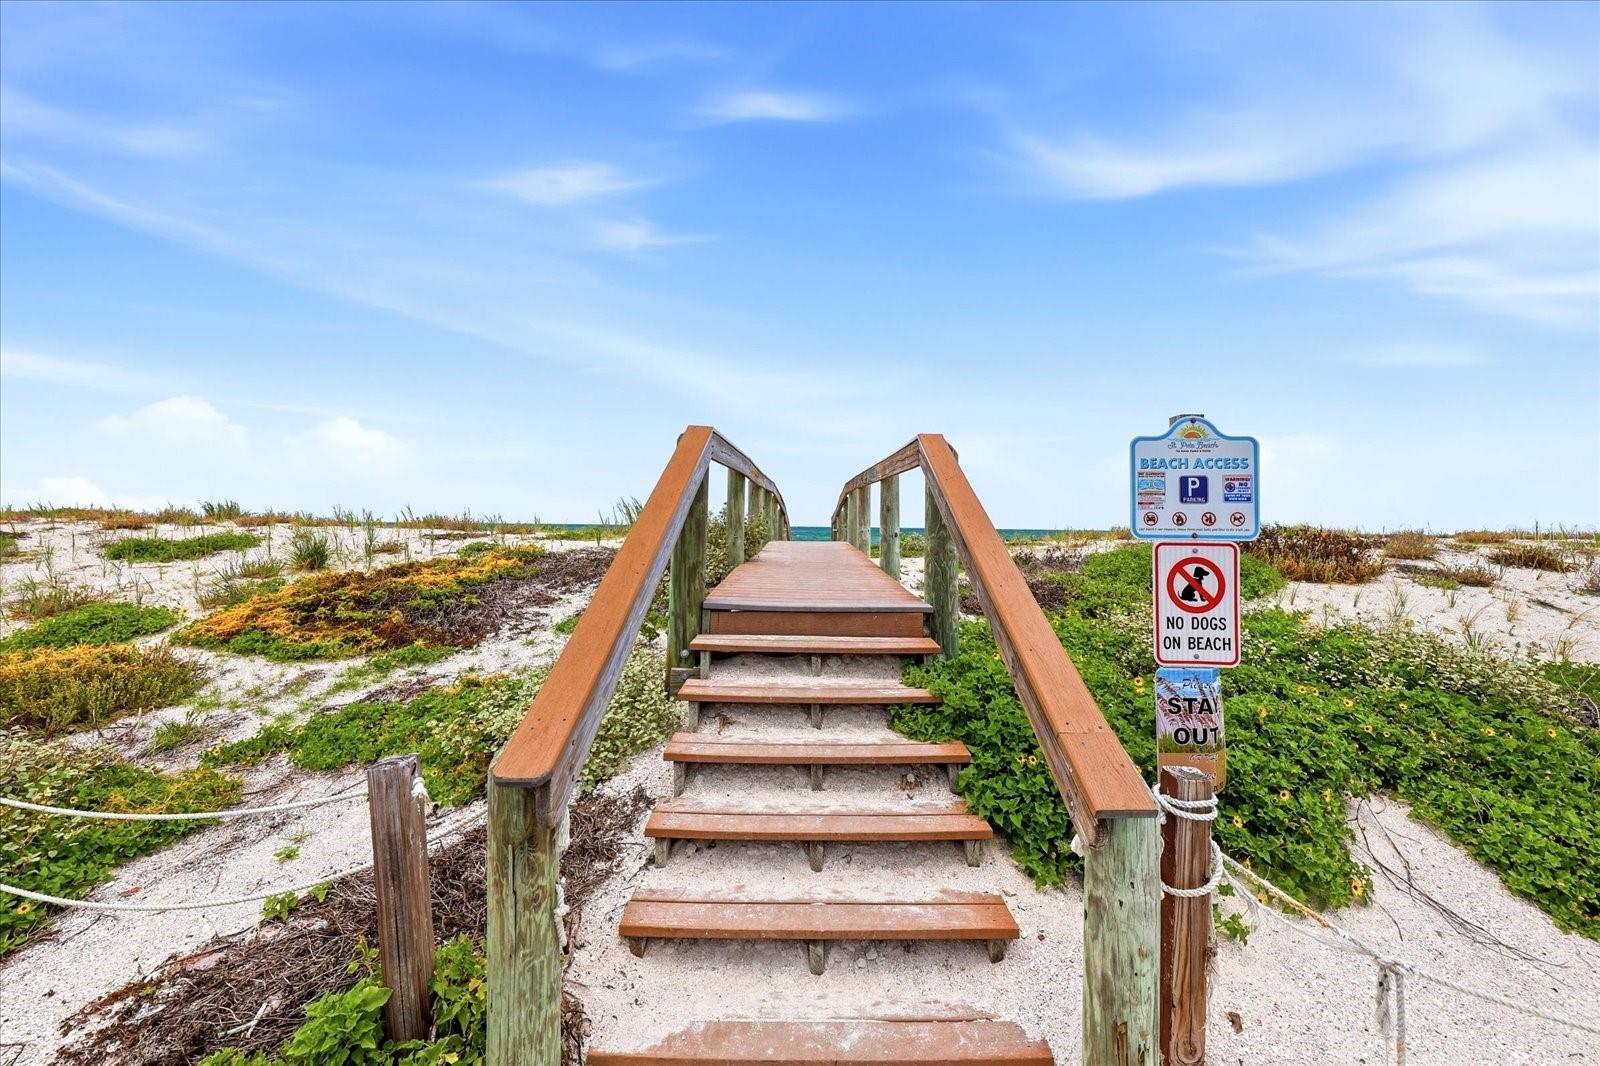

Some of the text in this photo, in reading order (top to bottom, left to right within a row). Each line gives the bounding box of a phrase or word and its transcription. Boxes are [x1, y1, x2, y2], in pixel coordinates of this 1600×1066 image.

[1140, 457, 1249, 469] BEACH ACCESS
[1188, 477, 1200, 497] P
[1166, 616, 1227, 631] NO DOGS
[1163, 636, 1231, 651] ON BEACH
[1173, 727, 1219, 745] OUT
